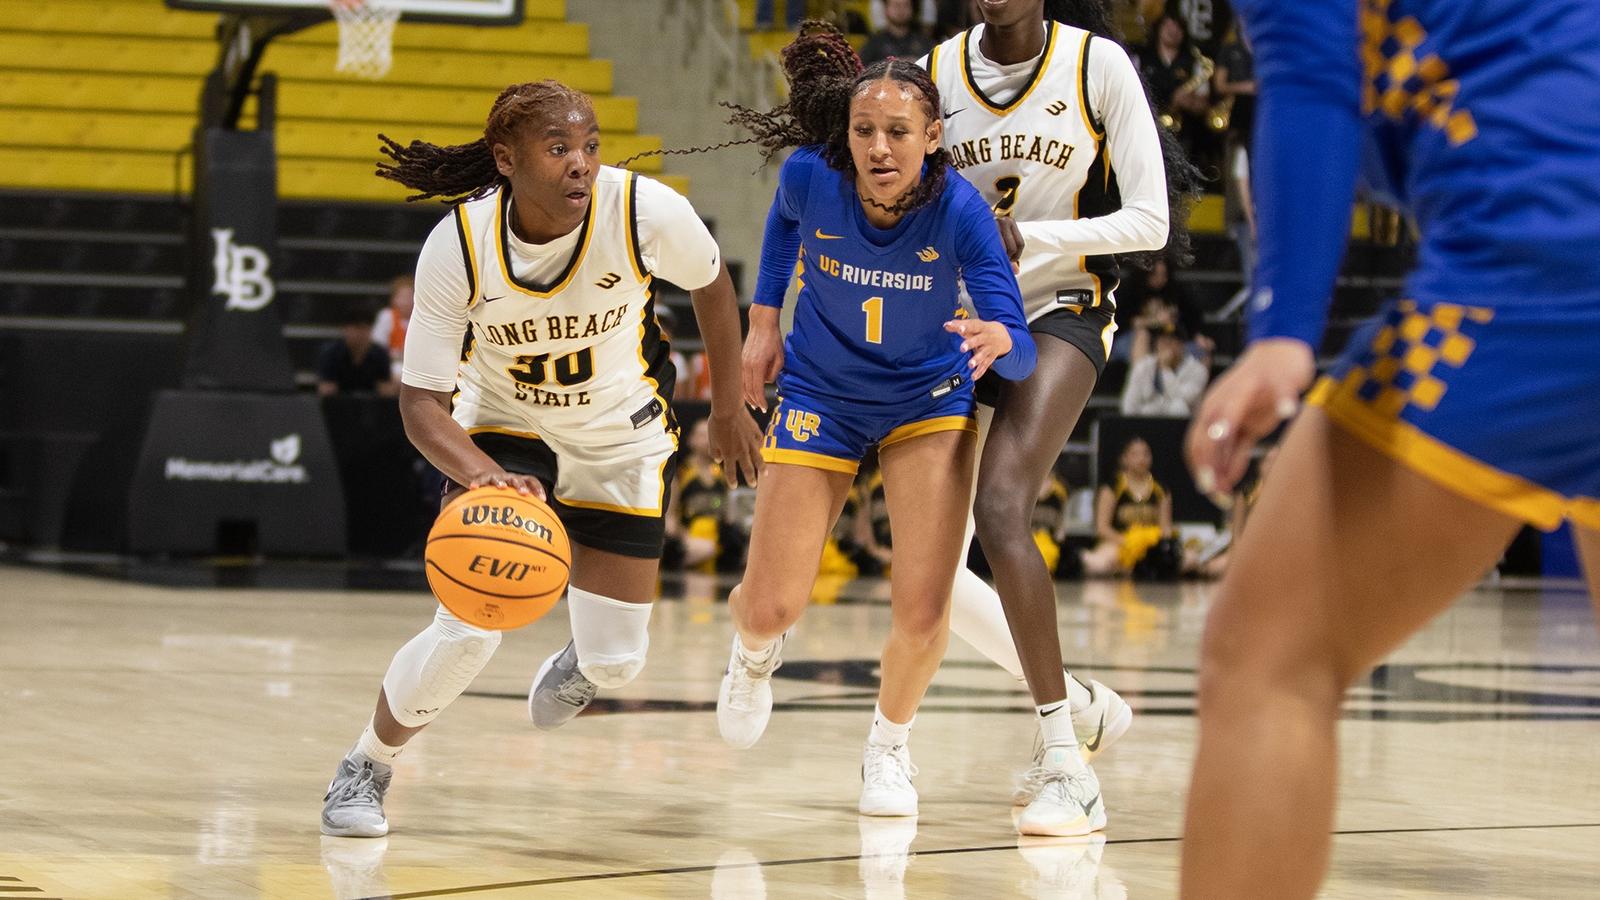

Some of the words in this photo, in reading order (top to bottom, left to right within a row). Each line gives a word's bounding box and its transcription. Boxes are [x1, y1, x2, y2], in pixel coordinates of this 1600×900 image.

[951, 137, 992, 170] ONG
[1001, 134, 1075, 170] BEACH
[993, 174, 1022, 217] 2
[210, 228, 275, 311] LB
[819, 254, 841, 277] UC
[842, 264, 934, 291] RIVERSIDE
[475, 319, 538, 346] LONG
[546, 303, 629, 340] BEACH
[861, 296, 884, 344] 1
[952, 378, 961, 387] M
[462, 505, 553, 545] Wilson
[468, 554, 531, 582] EVO
